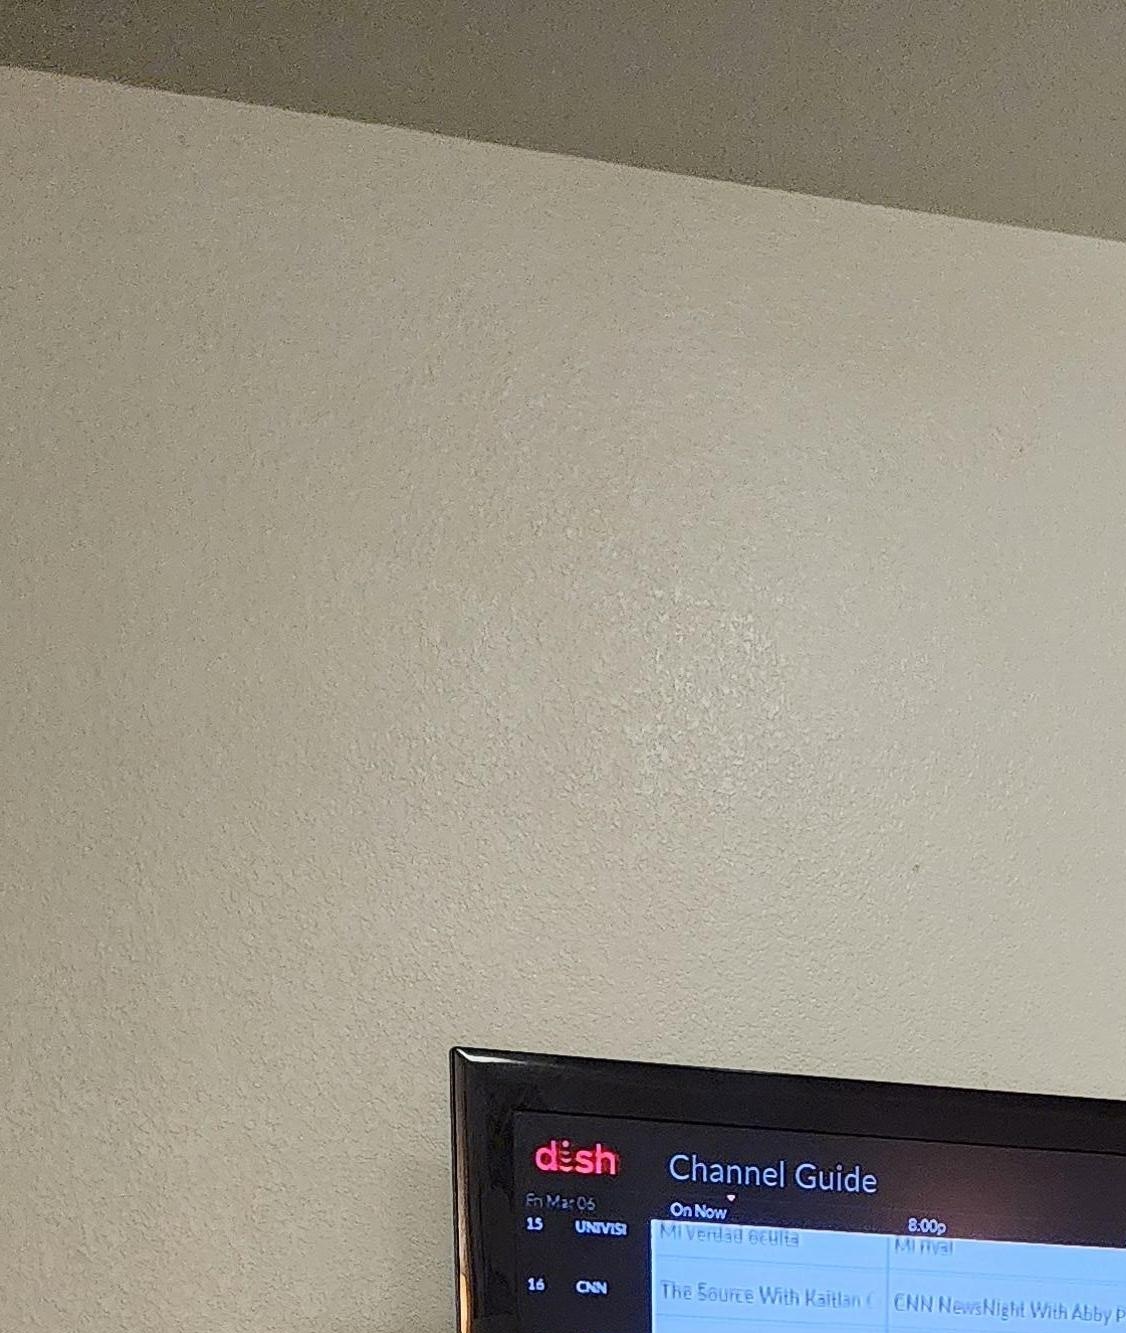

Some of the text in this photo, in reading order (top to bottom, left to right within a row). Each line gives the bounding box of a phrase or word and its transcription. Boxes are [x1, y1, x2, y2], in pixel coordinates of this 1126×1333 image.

[535, 1139, 617, 1176] dish
[669, 1153, 878, 1194] Channel Guide
[577, 1197, 596, 1212] 06
[670, 1202, 728, 1220] On Now
[526, 1216, 543, 1231] 15
[907, 1217, 948, 1237] 8:00p
[527, 1277, 545, 1291] 16
[575, 1280, 607, 1295] CNN
[661, 1280, 692, 1300] The
[697, 1282, 754, 1305] Source
[758, 1285, 800, 1307] With
[805, 1289, 862, 1309] Kaitlan
[894, 1293, 933, 1313] CNN
[938, 1297, 1026, 1322] NewsNight
[1030, 1302, 1069, 1321] With
[1071, 1304, 1112, 1325] Abby
